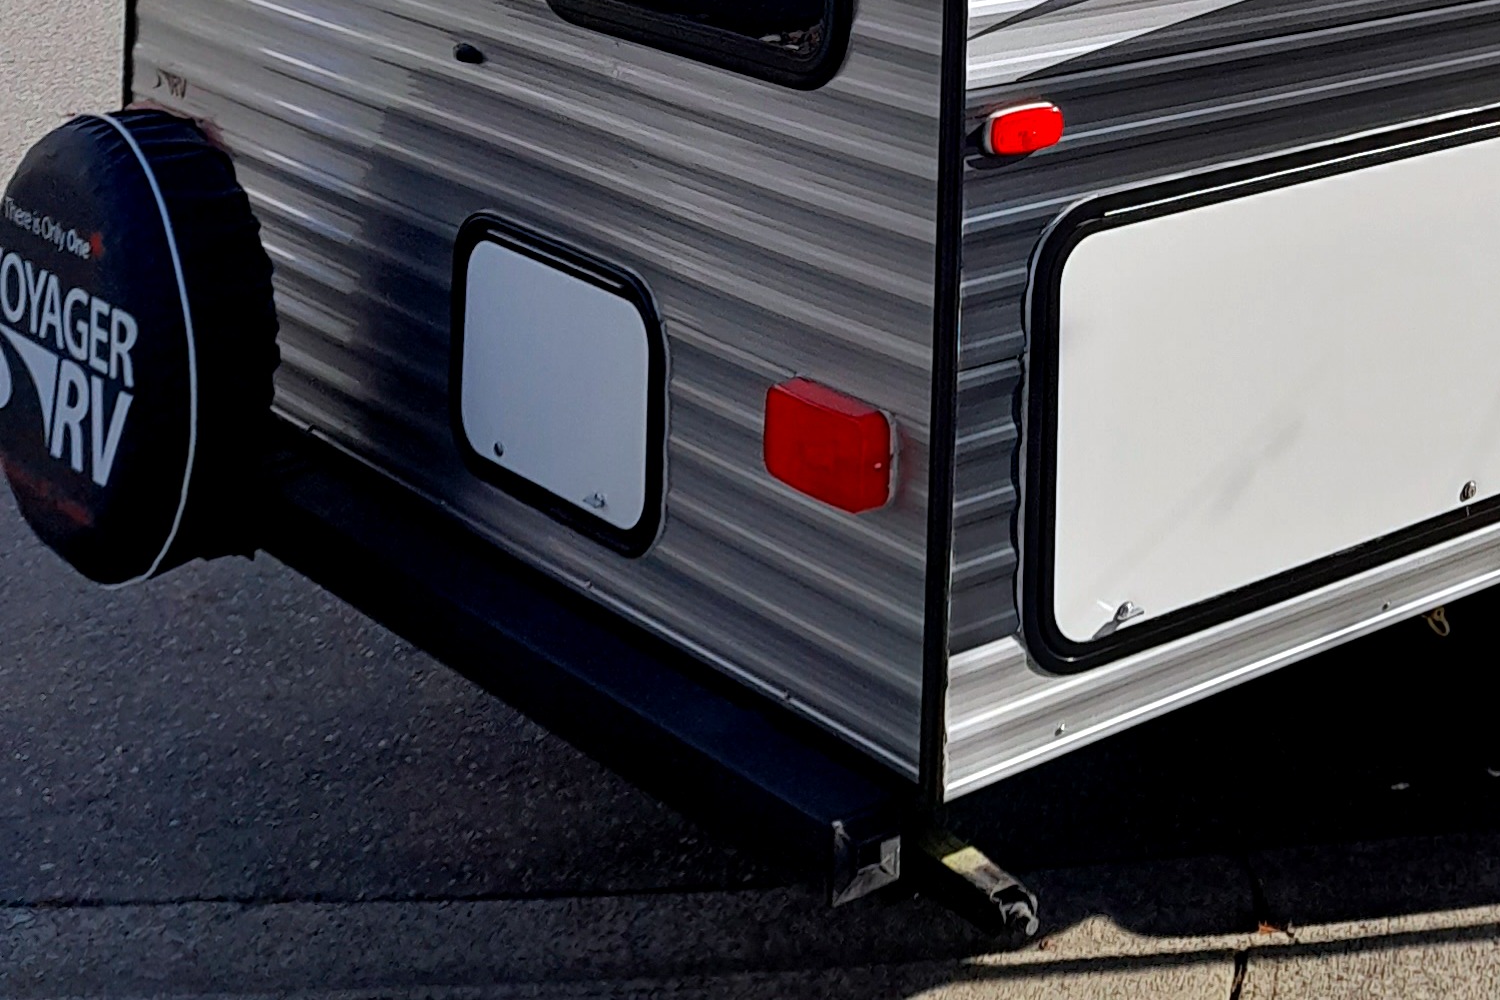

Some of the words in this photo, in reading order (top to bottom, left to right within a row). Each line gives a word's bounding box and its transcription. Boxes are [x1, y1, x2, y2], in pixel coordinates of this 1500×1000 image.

[4, 196, 32, 230] There
[32, 210, 40, 235] is
[41, 216, 67, 252] Only
[66, 228, 91, 259] One
[0, 251, 139, 388] OYAGER
[50, 357, 135, 488] RV
